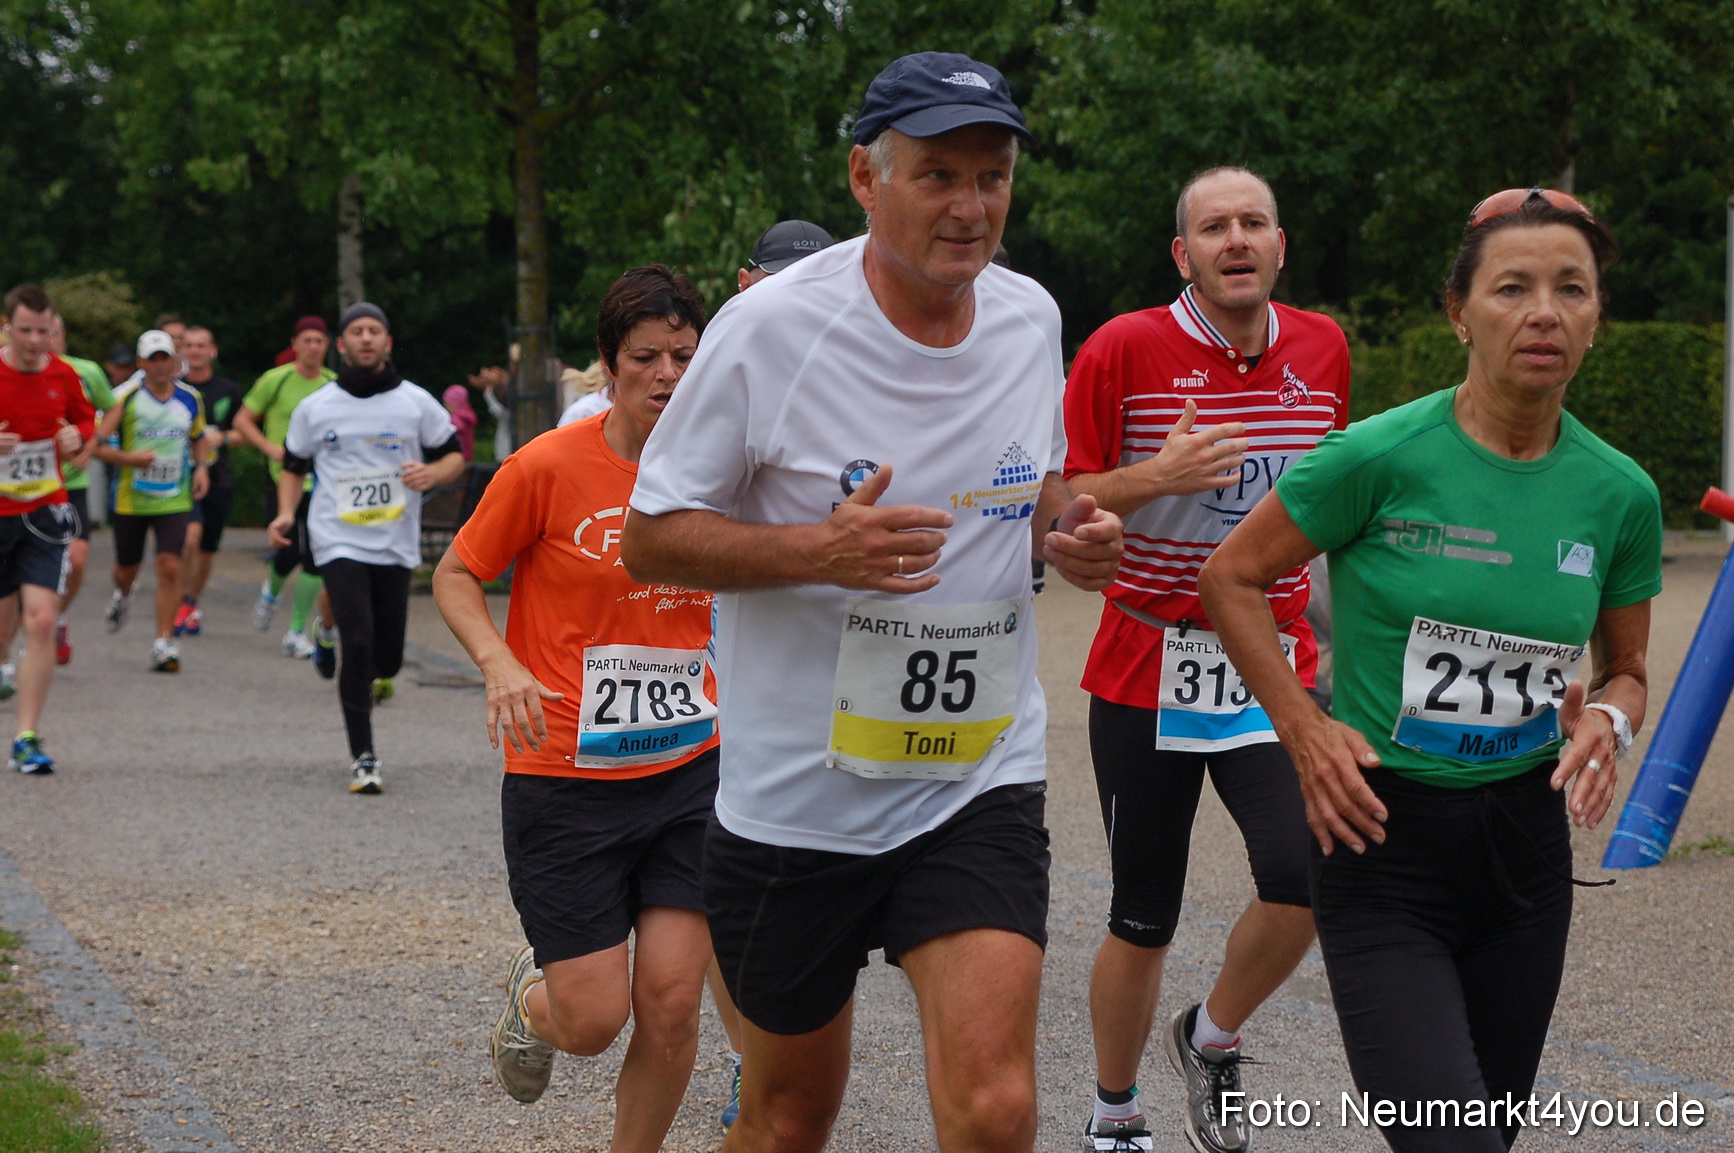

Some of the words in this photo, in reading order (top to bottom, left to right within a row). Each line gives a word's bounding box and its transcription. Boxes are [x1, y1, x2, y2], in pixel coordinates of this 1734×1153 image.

[792, 240, 821, 248] GORE
[1173, 377, 1205, 388] PUMA
[351, 482, 391, 507] 220
[950, 492, 979, 510] 14.
[974, 486, 1024, 499] Neumarkter
[628, 585, 651, 599] und
[848, 615, 915, 639] PARTL
[920, 620, 1001, 640] Neumarkt
[1166, 641, 1212, 654] PARTL
[1416, 620, 1482, 648] PARTL
[1487, 634, 1569, 660] Neumarkt
[587, 658, 626, 671] PARTL
[628, 659, 684, 675] Neumarkt
[900, 649, 978, 714] 85
[594, 678, 702, 726] 2783
[617, 732, 679, 754] Andrea
[903, 731, 957, 756] Toni
[1457, 732, 1520, 757] Maria
